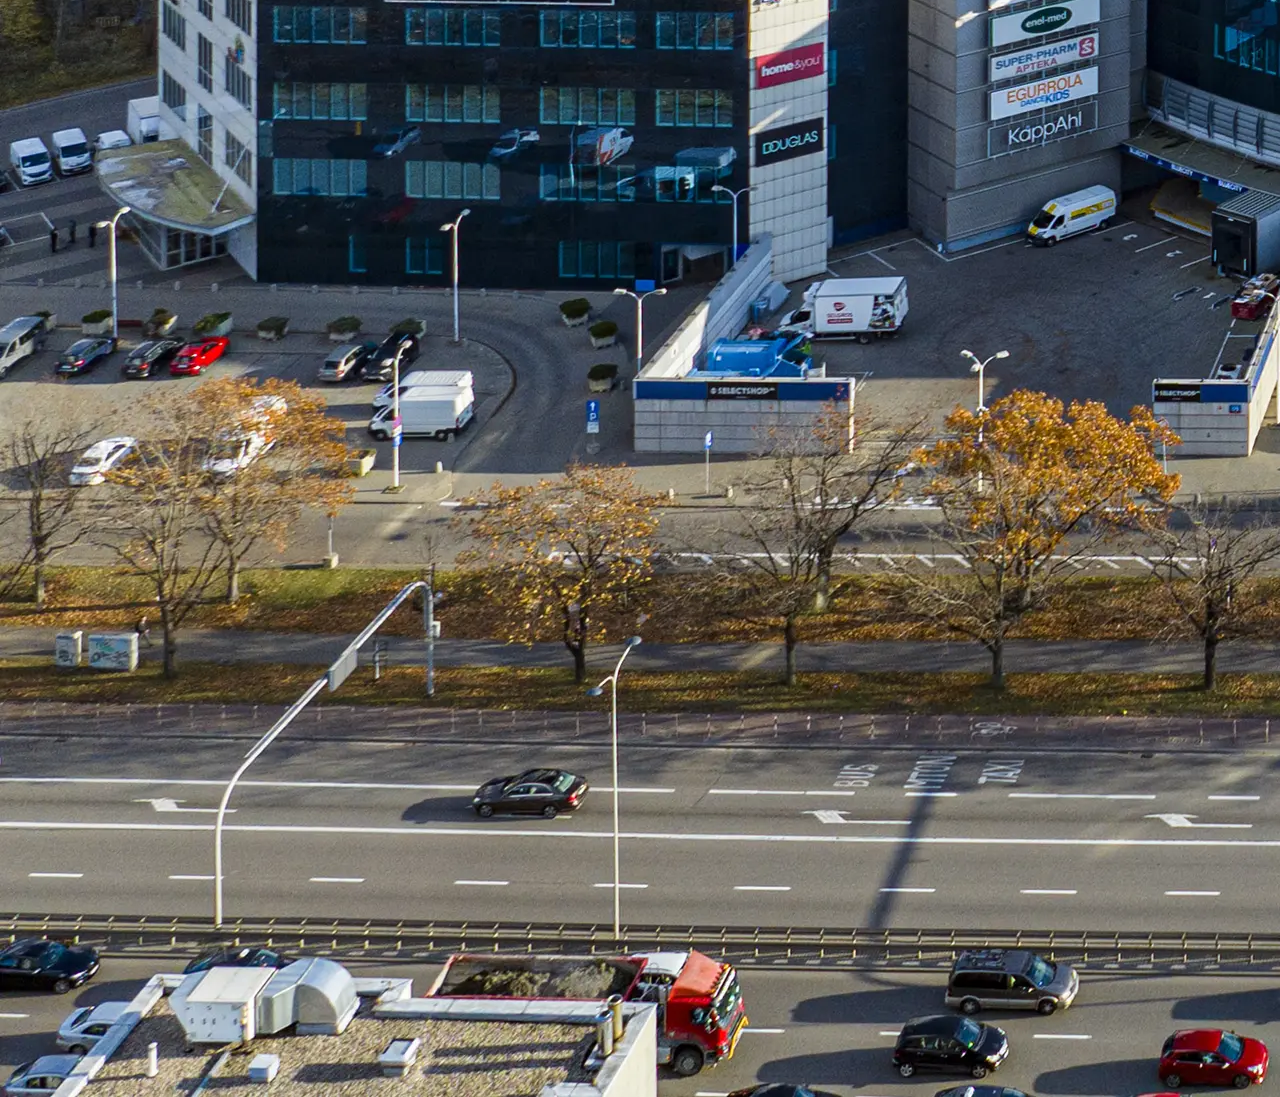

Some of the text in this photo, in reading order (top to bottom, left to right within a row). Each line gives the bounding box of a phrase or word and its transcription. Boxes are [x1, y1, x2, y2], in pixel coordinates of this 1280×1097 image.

[994, 42, 1078, 71] SUPER-PHARM
[1015, 57, 1058, 74] APTEKA
[1006, 73, 1083, 104] EGURROLA
[762, 129, 819, 155] DOUGLAS
[833, 764, 880, 787] BUS
[977, 759, 1026, 785] TAXI
